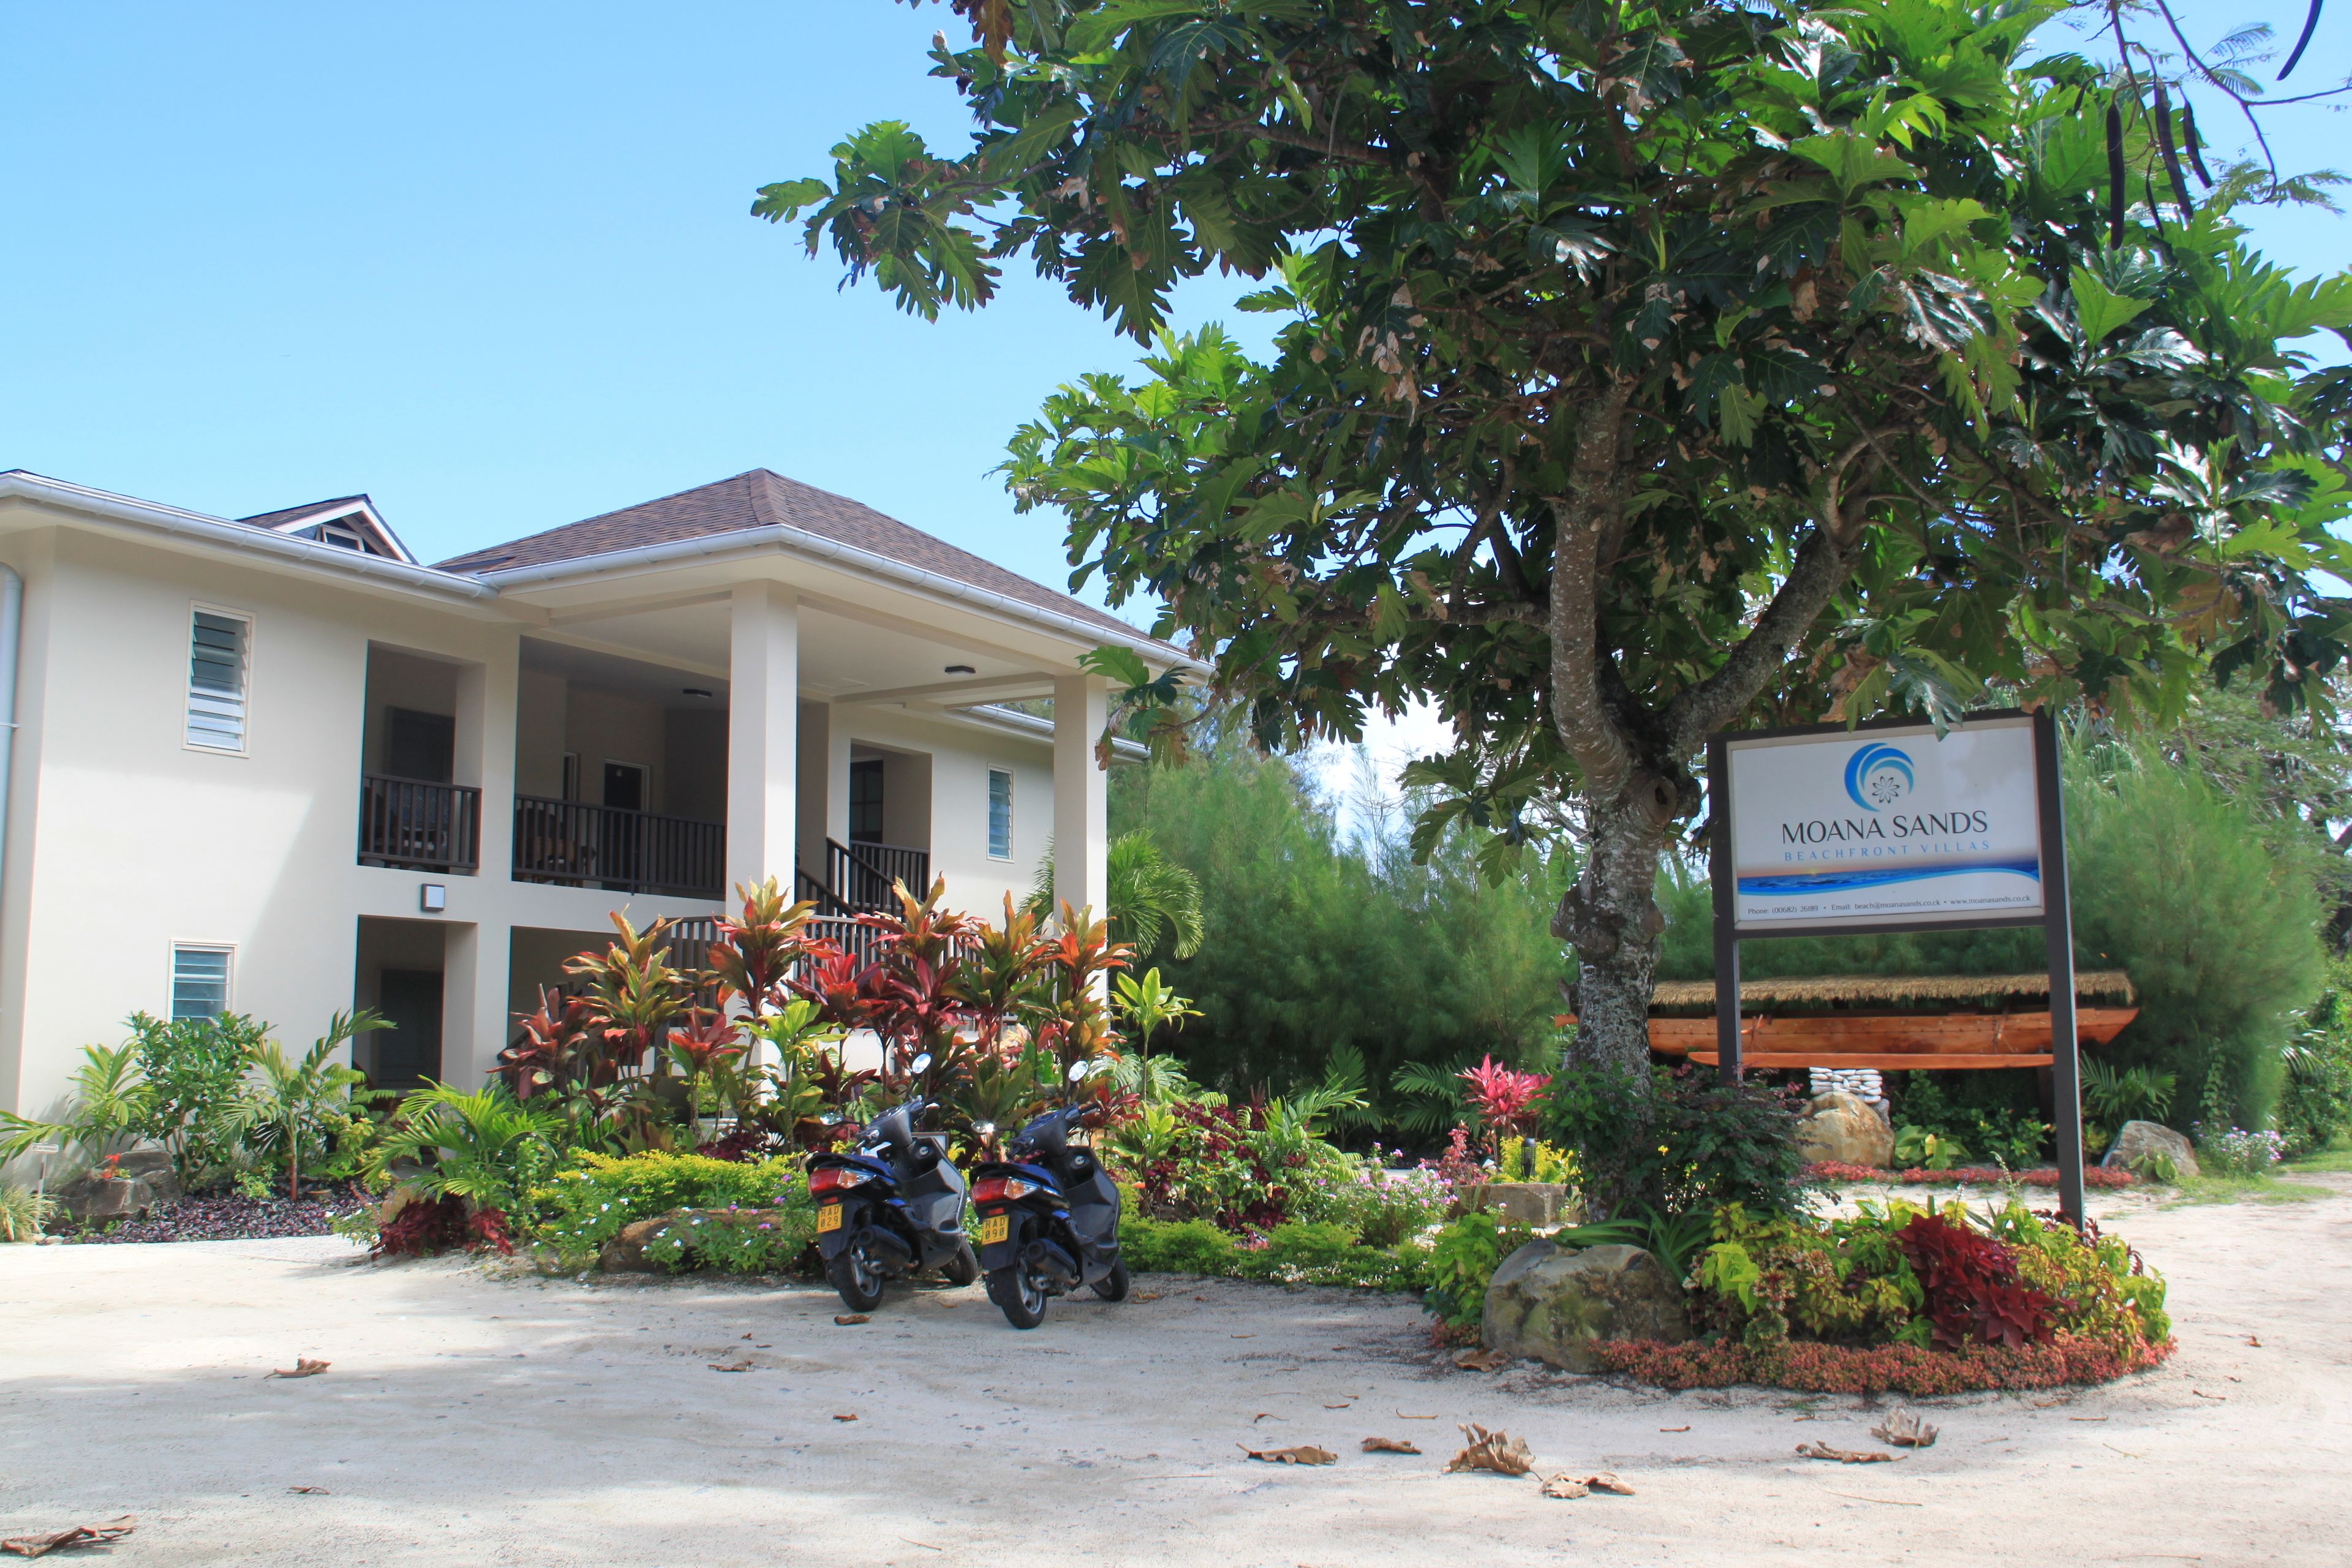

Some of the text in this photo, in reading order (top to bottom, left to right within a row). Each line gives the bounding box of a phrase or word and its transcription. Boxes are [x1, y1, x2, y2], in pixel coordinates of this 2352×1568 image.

[1782, 810, 1988, 844] MOANA SANDS
[1784, 840, 1990, 861] BEACHFRONT VILLAS
[1855, 899, 1940, 910] beach@moanasands.co.ck
[1950, 895, 2030, 905] www.moanasands.co.ck
[821, 1205, 839, 1218] RAD
[820, 1215, 838, 1227] 029
[986, 1216, 1005, 1229] RAD
[985, 1227, 1005, 1240] 090
